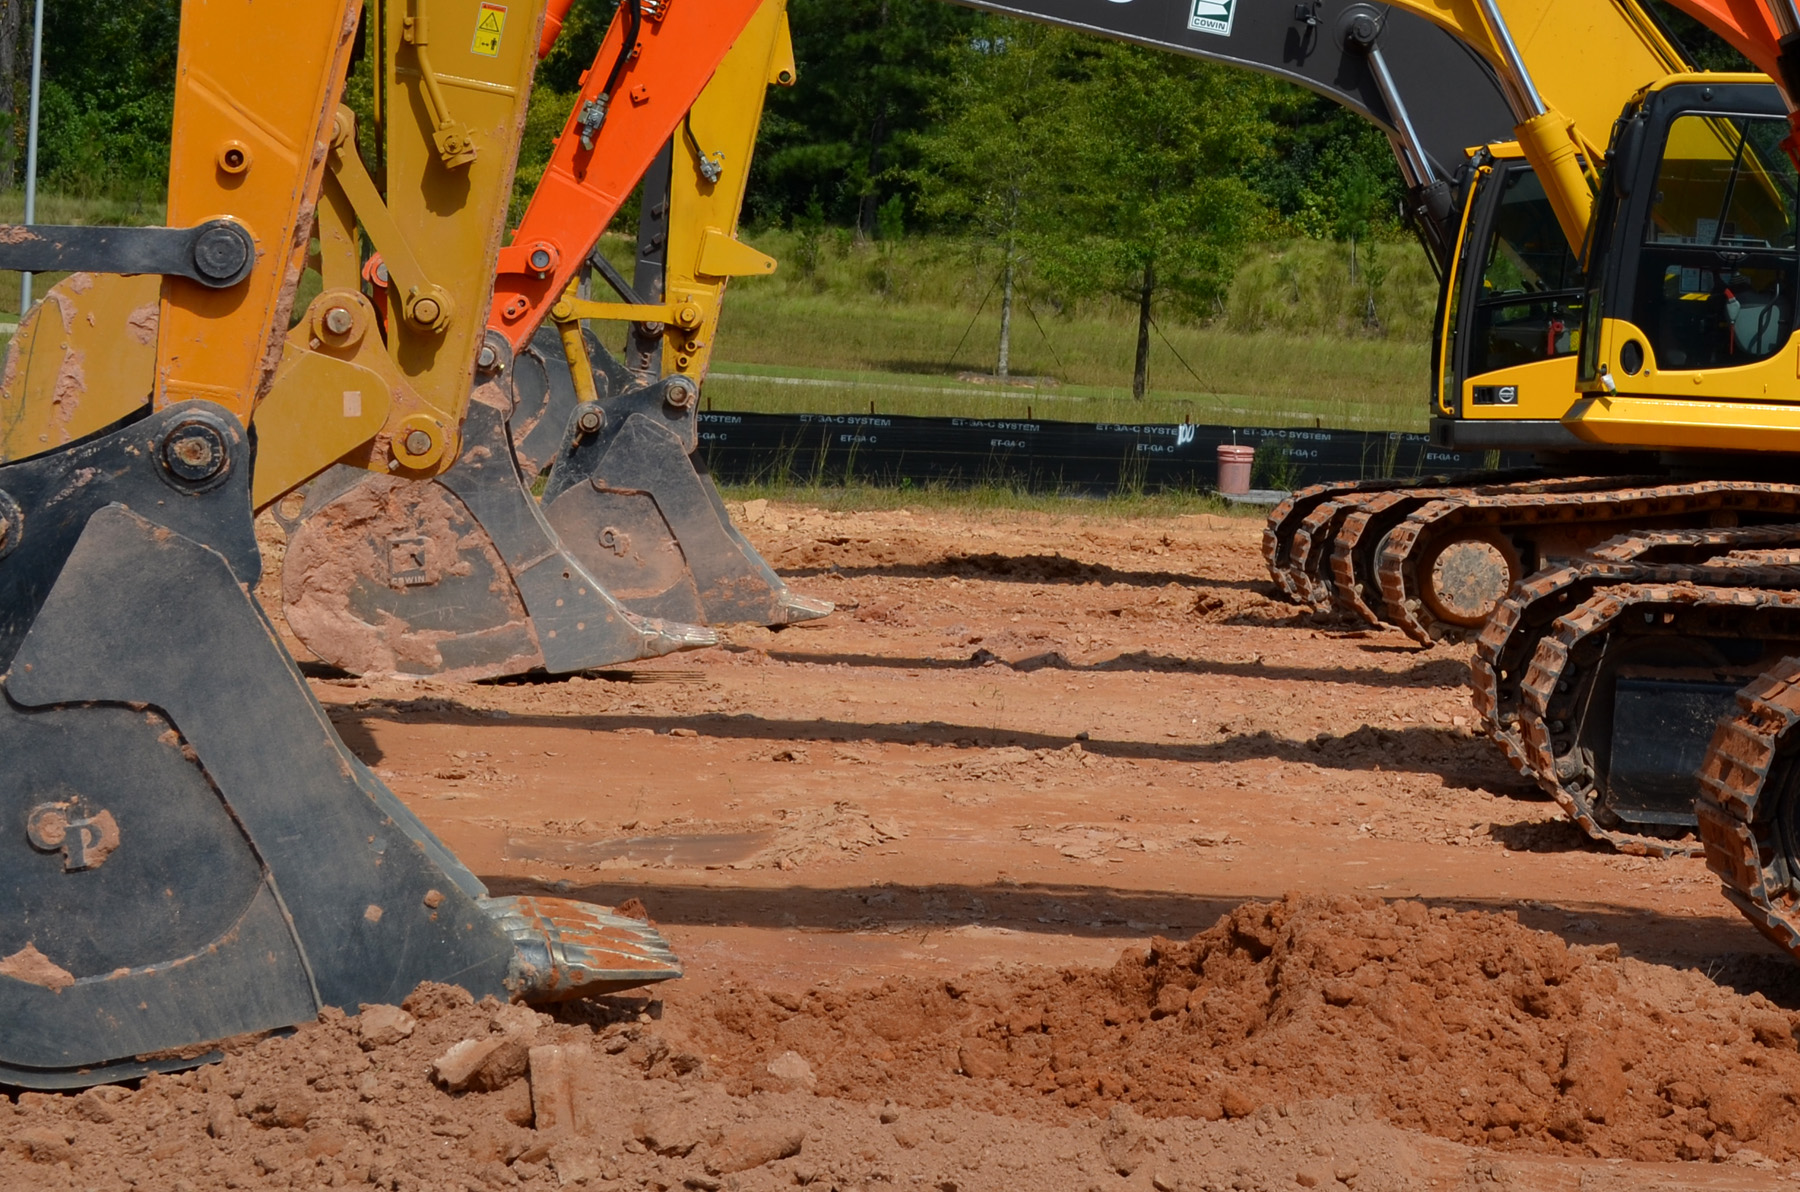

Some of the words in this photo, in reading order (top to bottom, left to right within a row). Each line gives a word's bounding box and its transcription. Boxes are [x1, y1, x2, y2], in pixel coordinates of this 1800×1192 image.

[1193, 18, 1226, 30] COWIN
[697, 414, 742, 424] SYSTEM
[847, 417, 891, 427] SYSTEM
[997, 421, 1041, 432] SYSTEM
[1143, 426, 1179, 436] SYSTE
[1289, 431, 1332, 441] SYSTEM
